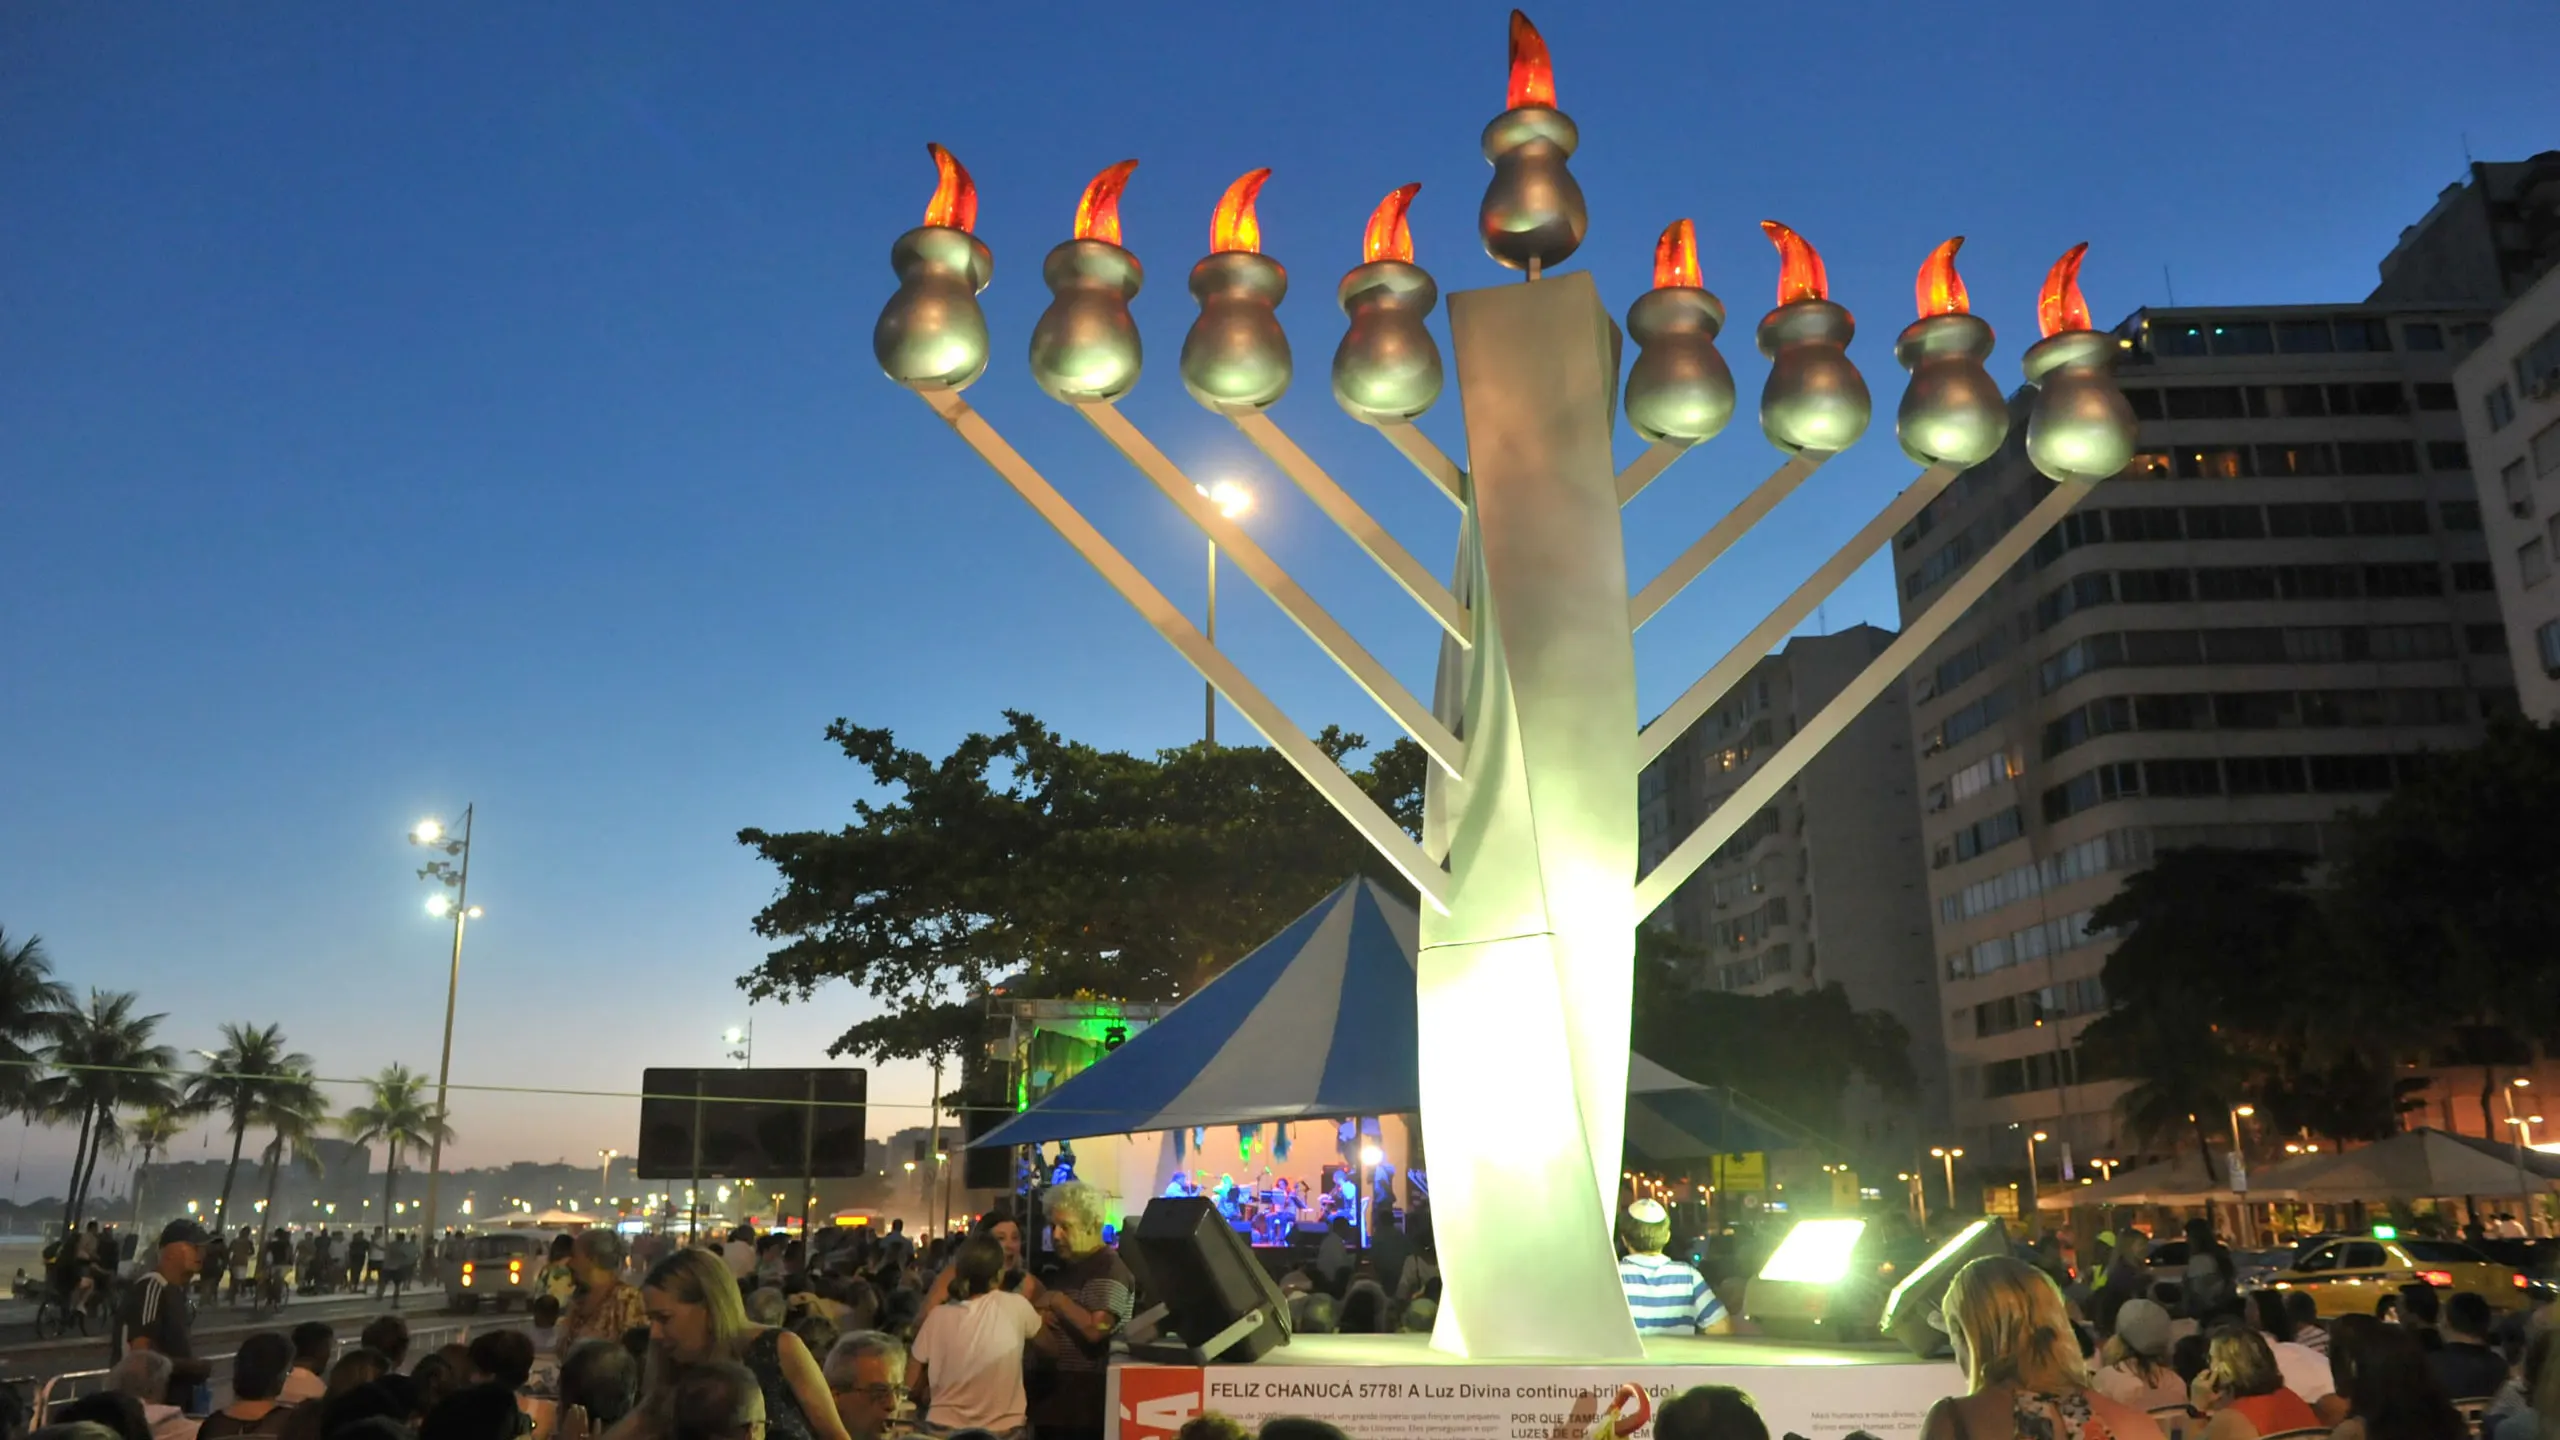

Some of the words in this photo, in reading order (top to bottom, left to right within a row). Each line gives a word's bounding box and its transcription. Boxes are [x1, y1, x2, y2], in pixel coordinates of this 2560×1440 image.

[1211, 1383, 1260, 1398] FELIZ
[1265, 1379, 1354, 1398] CHANUCÁ
[1359, 1383, 1402, 1398] 5778!
[1407, 1384, 1420, 1398] A
[1425, 1384, 1454, 1398] Luz
[1459, 1383, 1511, 1398] Divina
[1516, 1384, 1588, 1398] continua
[1511, 1413, 1536, 1424] POR
[1539, 1413, 1564, 1424] QUE
[1568, 1413, 1606, 1424] TAMB
[1511, 1428, 1549, 1439] LUZES
[1552, 1428, 1569, 1439] DE
